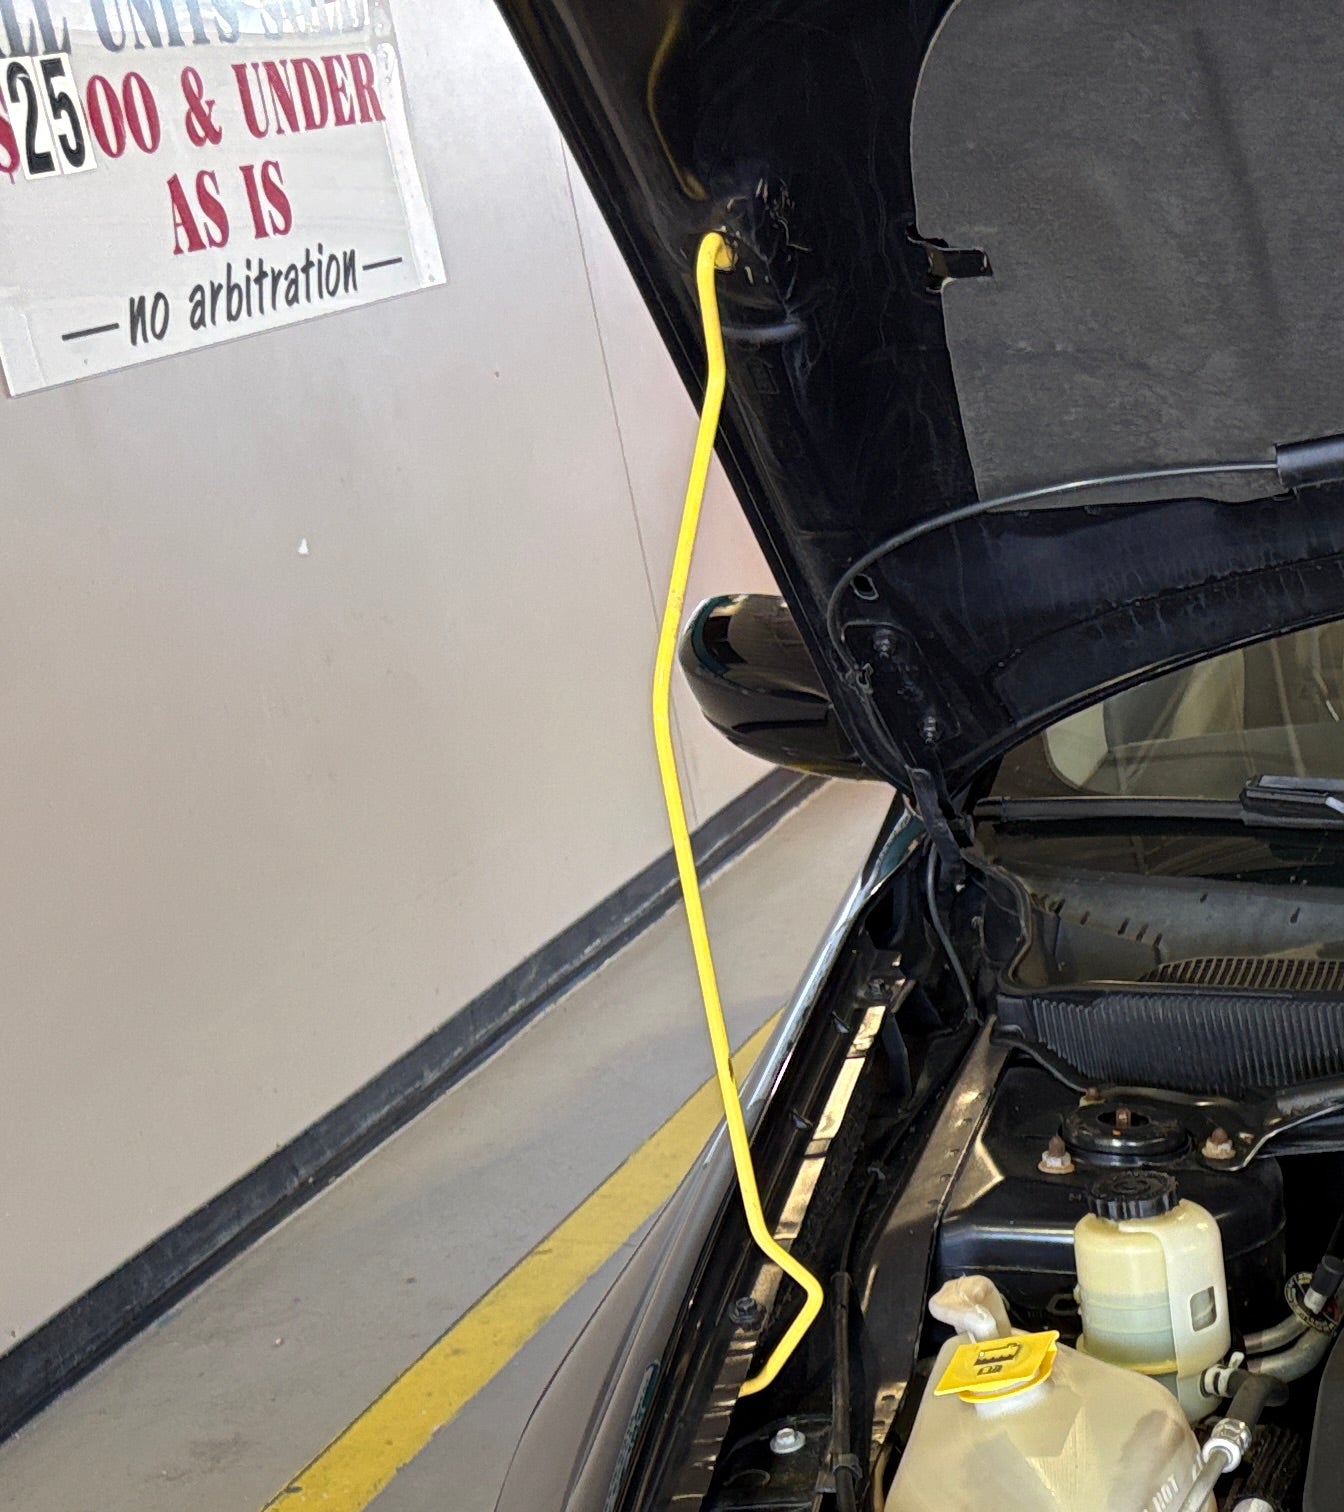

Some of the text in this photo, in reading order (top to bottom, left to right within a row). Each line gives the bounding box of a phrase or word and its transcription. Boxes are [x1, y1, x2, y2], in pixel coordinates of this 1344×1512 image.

[0, 0, 72, 57] LL
[181, 66, 222, 147] &
[232, 52, 386, 139] UNDER
[167, 160, 293, 255] AS IS
[190, 243, 358, 331] arbitration
